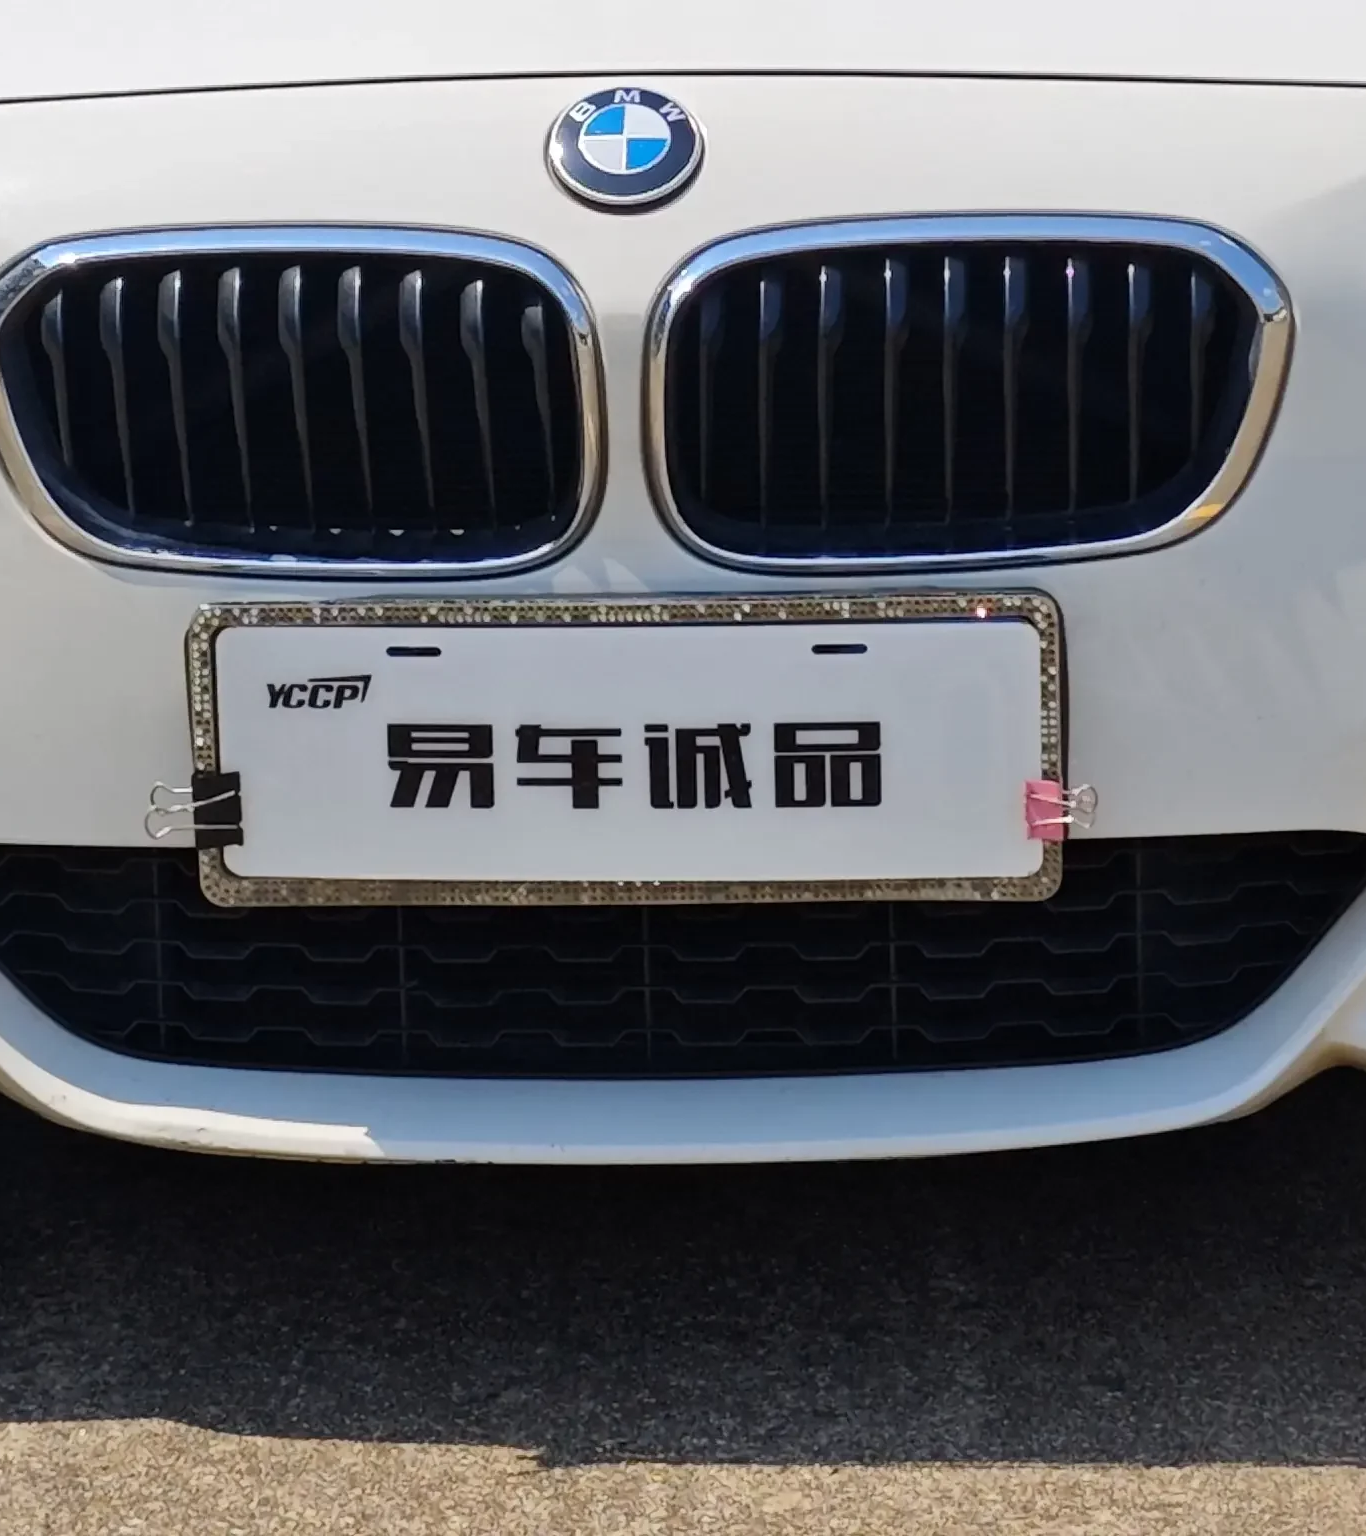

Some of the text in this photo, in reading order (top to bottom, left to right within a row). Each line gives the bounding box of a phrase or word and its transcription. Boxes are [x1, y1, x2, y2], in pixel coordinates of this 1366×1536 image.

[569, 89, 686, 123] BMW
[266, 681, 363, 709] YCCP
[386, 721, 882, 810] 易车诚品
